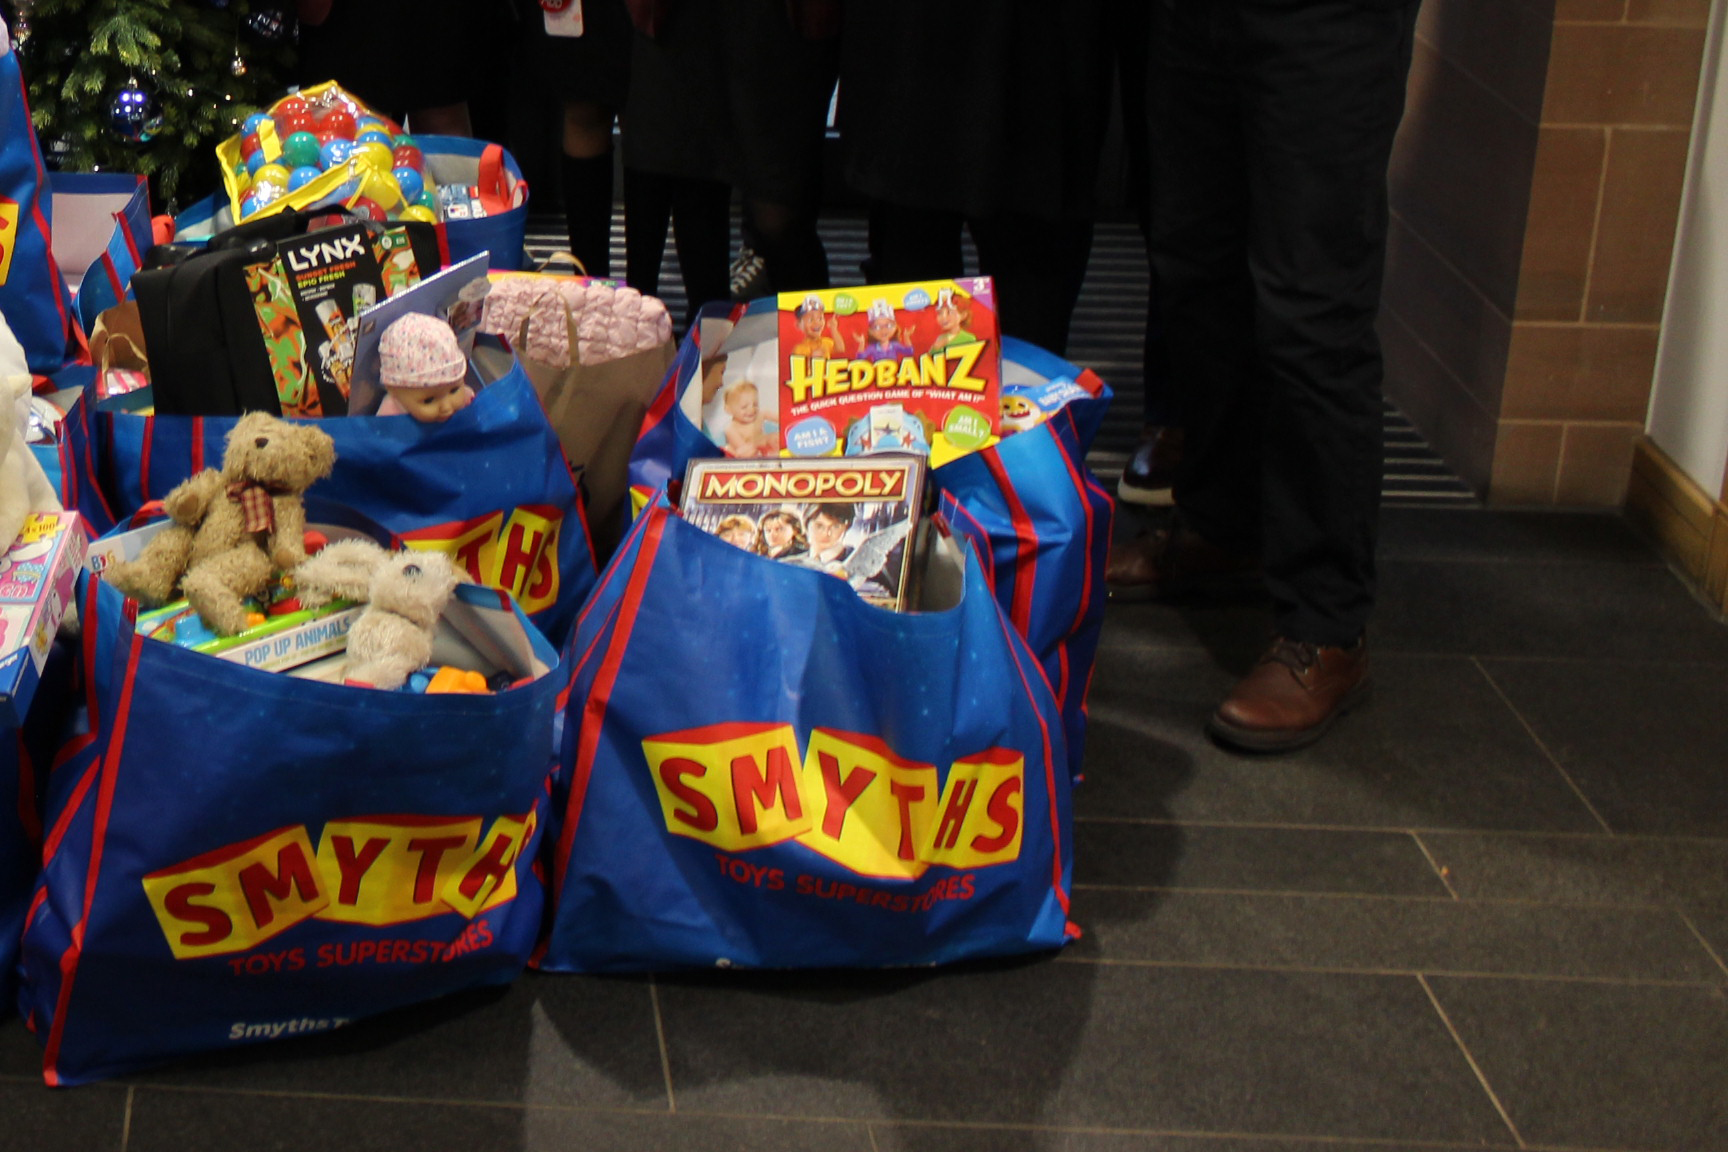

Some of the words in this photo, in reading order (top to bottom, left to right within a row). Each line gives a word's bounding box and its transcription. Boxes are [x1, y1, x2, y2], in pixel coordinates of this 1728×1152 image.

[287, 234, 365, 271] LYNX
[297, 278, 317, 289] EPIC
[318, 271, 346, 285] FRESH
[329, 261, 356, 275] FRESH
[786, 339, 989, 404] HEDBANZ
[791, 406, 810, 416] THE
[811, 401, 838, 411] QUICK
[839, 393, 883, 405] QUESTION
[885, 390, 910, 399] GAME
[912, 390, 924, 398] OF
[957, 393, 971, 401] AM
[949, 423, 985, 438] SMALL?
[958, 415, 971, 426] AM
[794, 432, 811, 442] AM
[797, 437, 829, 449] FISH?
[705, 471, 901, 499] MONOPOLY
[244, 641, 270, 665] POP
[273, 637, 290, 658] UP
[295, 616, 352, 652] ANIMALS
[659, 744, 1022, 862] SMYTHS
[715, 853, 785, 890] TOYS
[796, 874, 975, 914] SUPERSTORES
[228, 944, 305, 977] TOYS
[316, 921, 494, 969] SUPERSTORES
